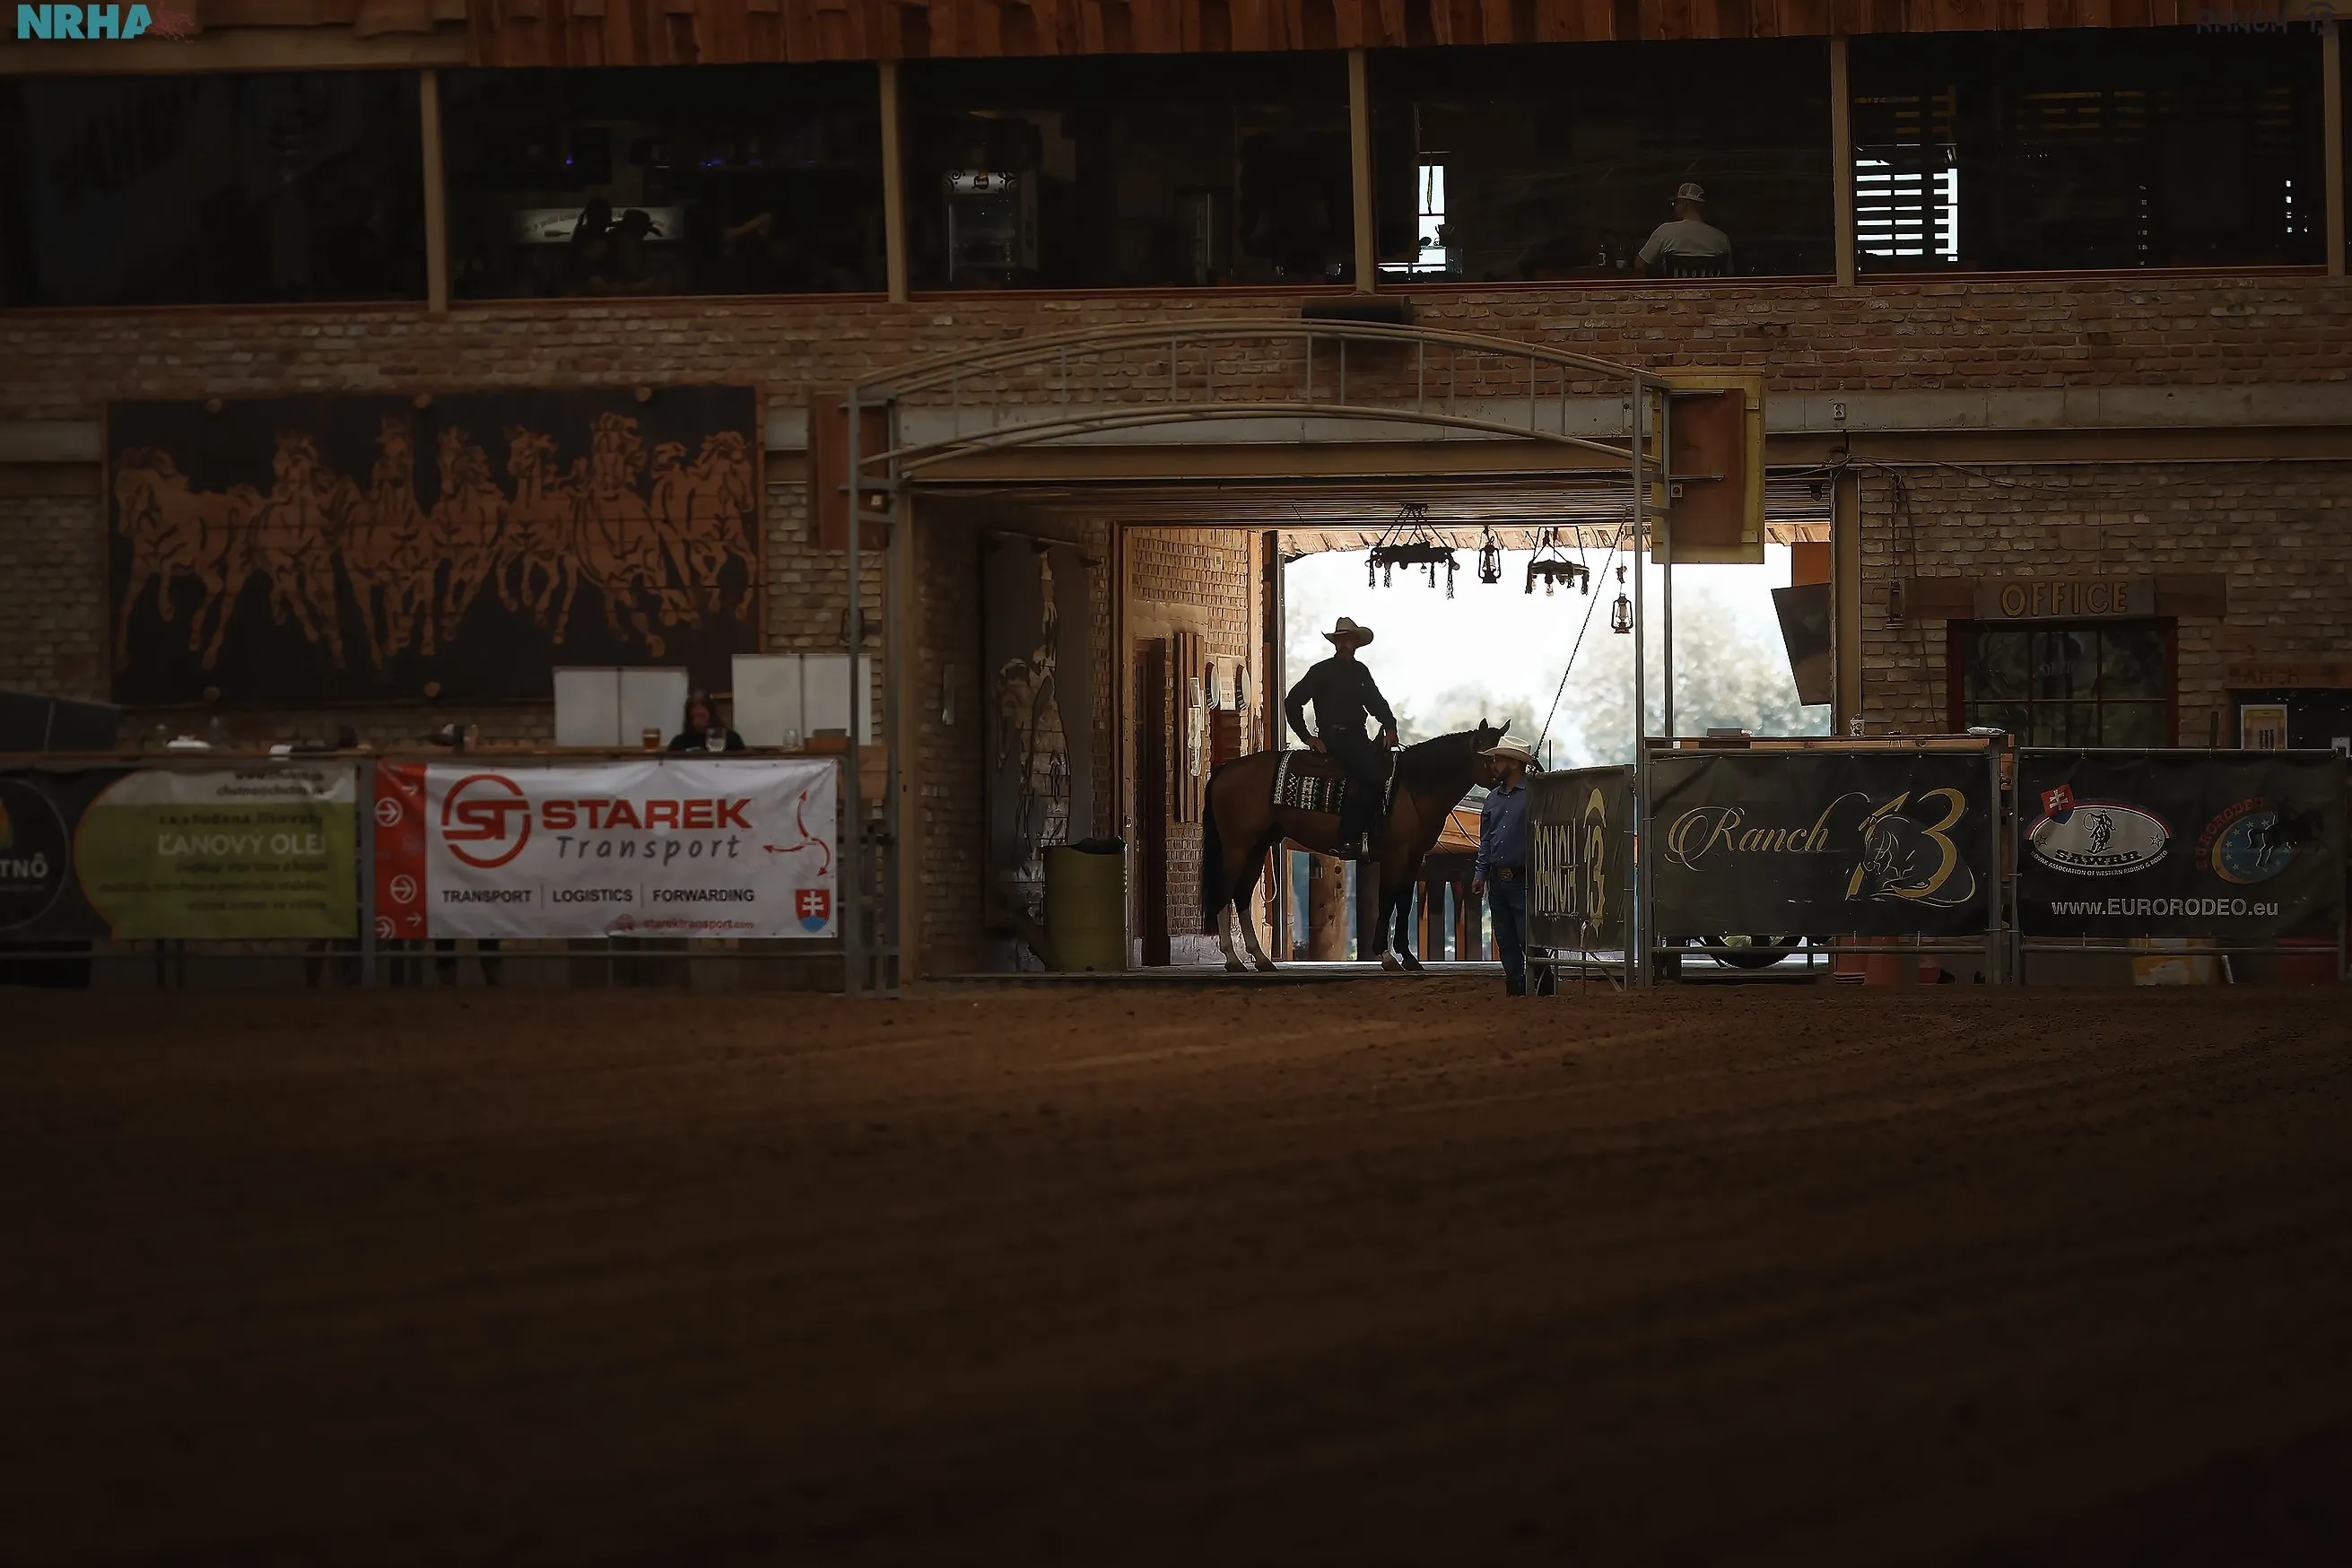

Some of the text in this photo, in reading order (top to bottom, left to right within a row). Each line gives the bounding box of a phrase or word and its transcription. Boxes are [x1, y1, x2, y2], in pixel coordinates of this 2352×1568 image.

[2001, 581, 2128, 617] OFFICE
[541, 798, 753, 830] STAREK
[157, 828, 327, 855] ĽANOVÝ OLEJ
[1665, 791, 1871, 872] Ranch
[555, 836, 742, 867] Transport
[2049, 863, 2087, 876] ASSOCIATION
[2095, 869, 2124, 877] WESTERN
[2123, 864, 2146, 875] RIDING
[2150, 849, 2169, 867] RODEO
[442, 889, 754, 903] TRANSPORT LOGISTICS FORWARDING
[2051, 898, 2278, 916] www.EURORODEO.eu
